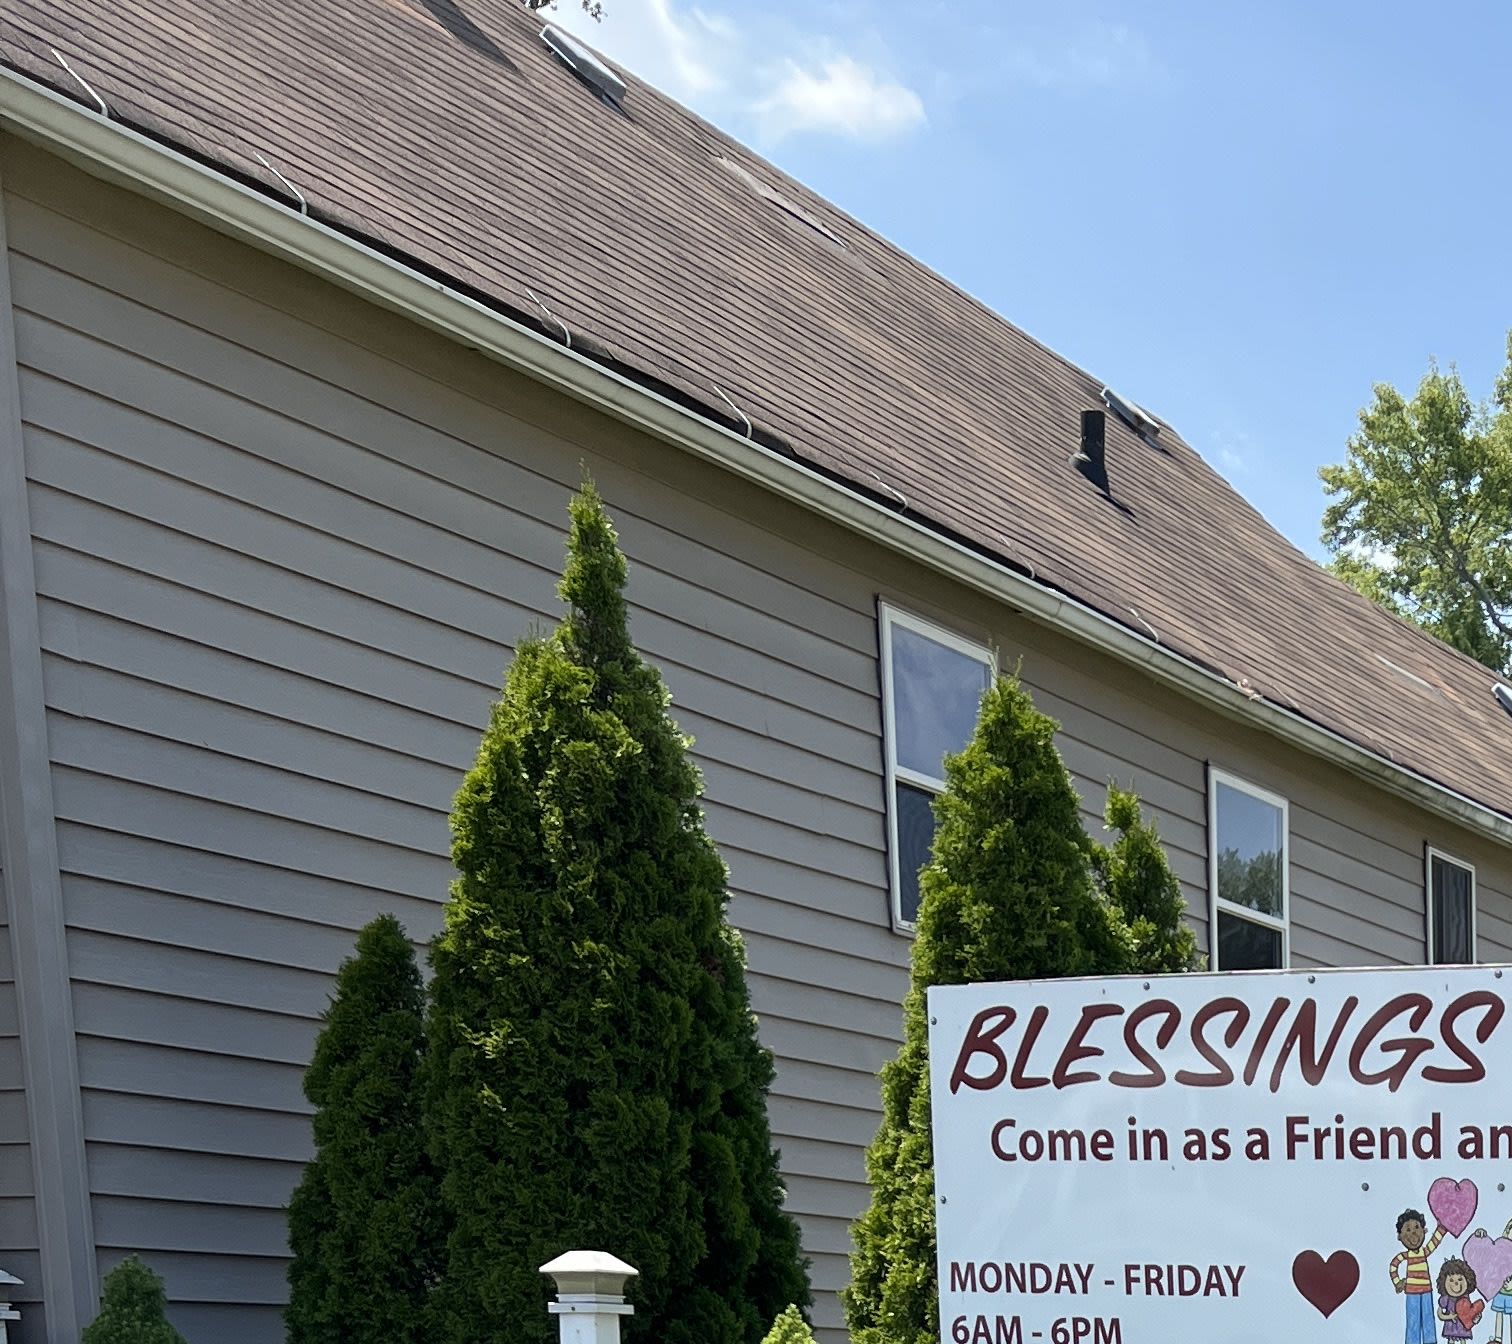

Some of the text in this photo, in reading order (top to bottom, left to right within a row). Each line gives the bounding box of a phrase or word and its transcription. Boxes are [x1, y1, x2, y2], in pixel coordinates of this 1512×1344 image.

[950, 991, 1505, 1095] BLESSINGS
[991, 1118, 1115, 1162] Come
[1127, 1116, 1169, 1161] in
[1182, 1128, 1232, 1161] as
[1244, 1127, 1270, 1161] a
[1285, 1111, 1442, 1161] Friend
[950, 1261, 1095, 1295] MONDAY
[1124, 1264, 1246, 1297] FRIDAY
